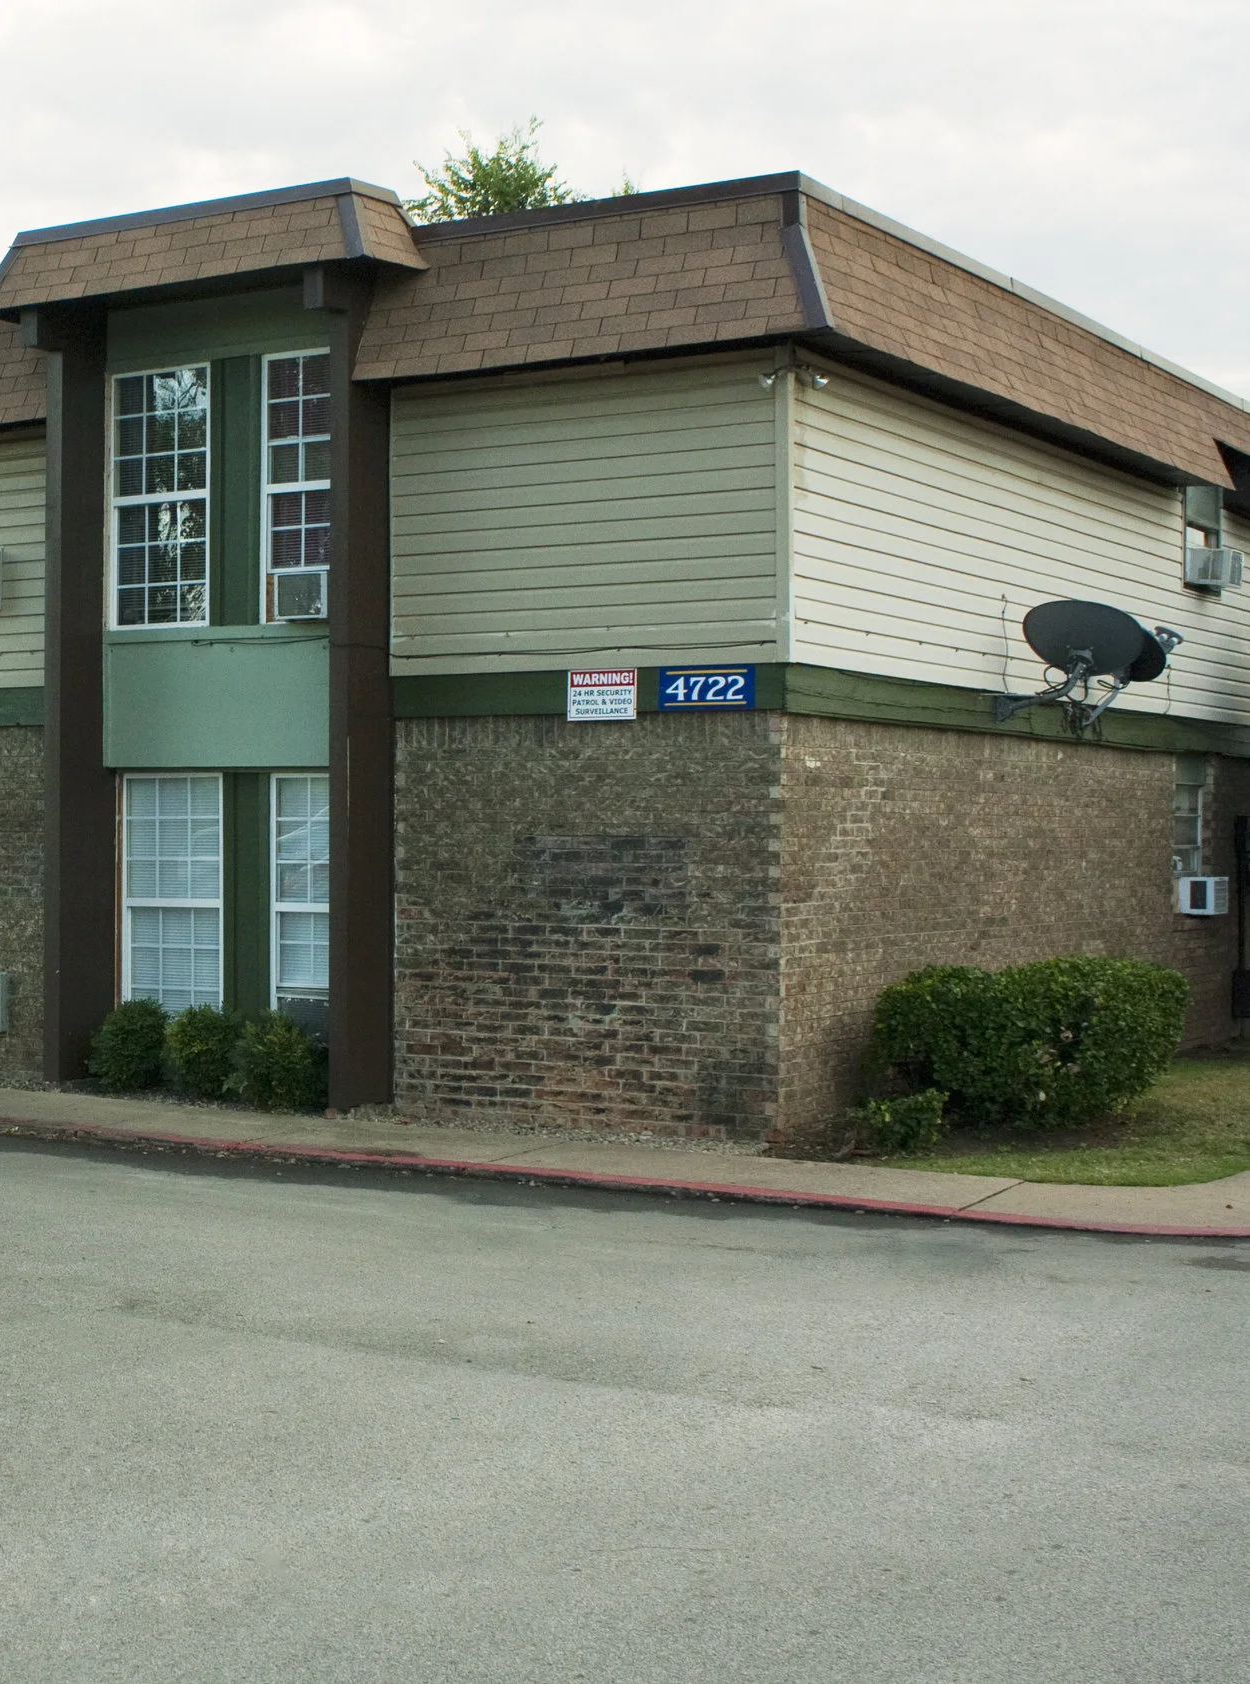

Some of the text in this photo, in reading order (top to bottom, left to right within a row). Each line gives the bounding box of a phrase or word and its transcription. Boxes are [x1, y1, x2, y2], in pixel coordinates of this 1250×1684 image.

[572, 672, 633, 686] WARNING!
[665, 675, 745, 701] 4722
[572, 689, 632, 697] 24 HR SECURITY
[601, 698, 607, 706] &
[575, 707, 629, 715] SURVEILLANCE
